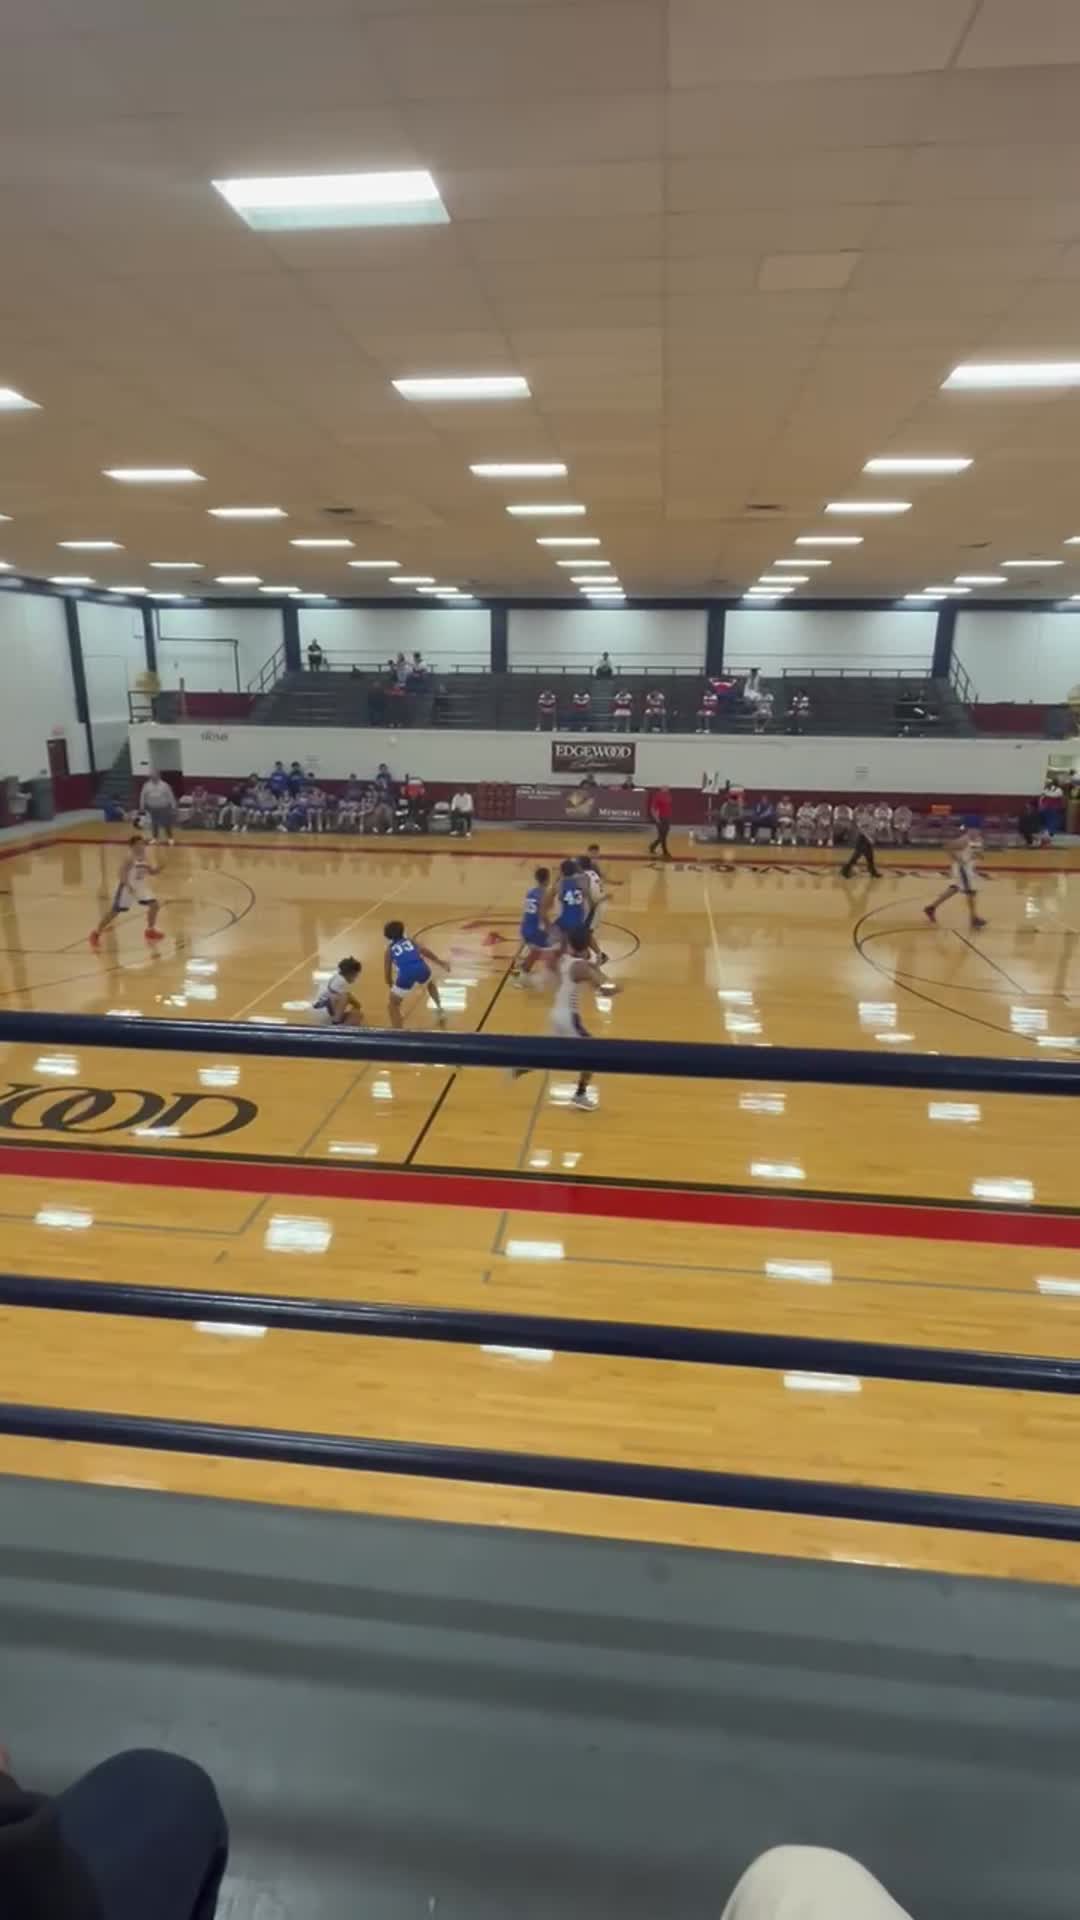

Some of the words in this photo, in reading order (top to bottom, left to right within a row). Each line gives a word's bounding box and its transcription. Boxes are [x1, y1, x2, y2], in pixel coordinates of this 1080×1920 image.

[555, 744, 632, 758] EDGEWOOD
[563, 889, 583, 905] 43
[391, 940, 414, 957] 33
[0, 1083, 258, 1139] OOD
